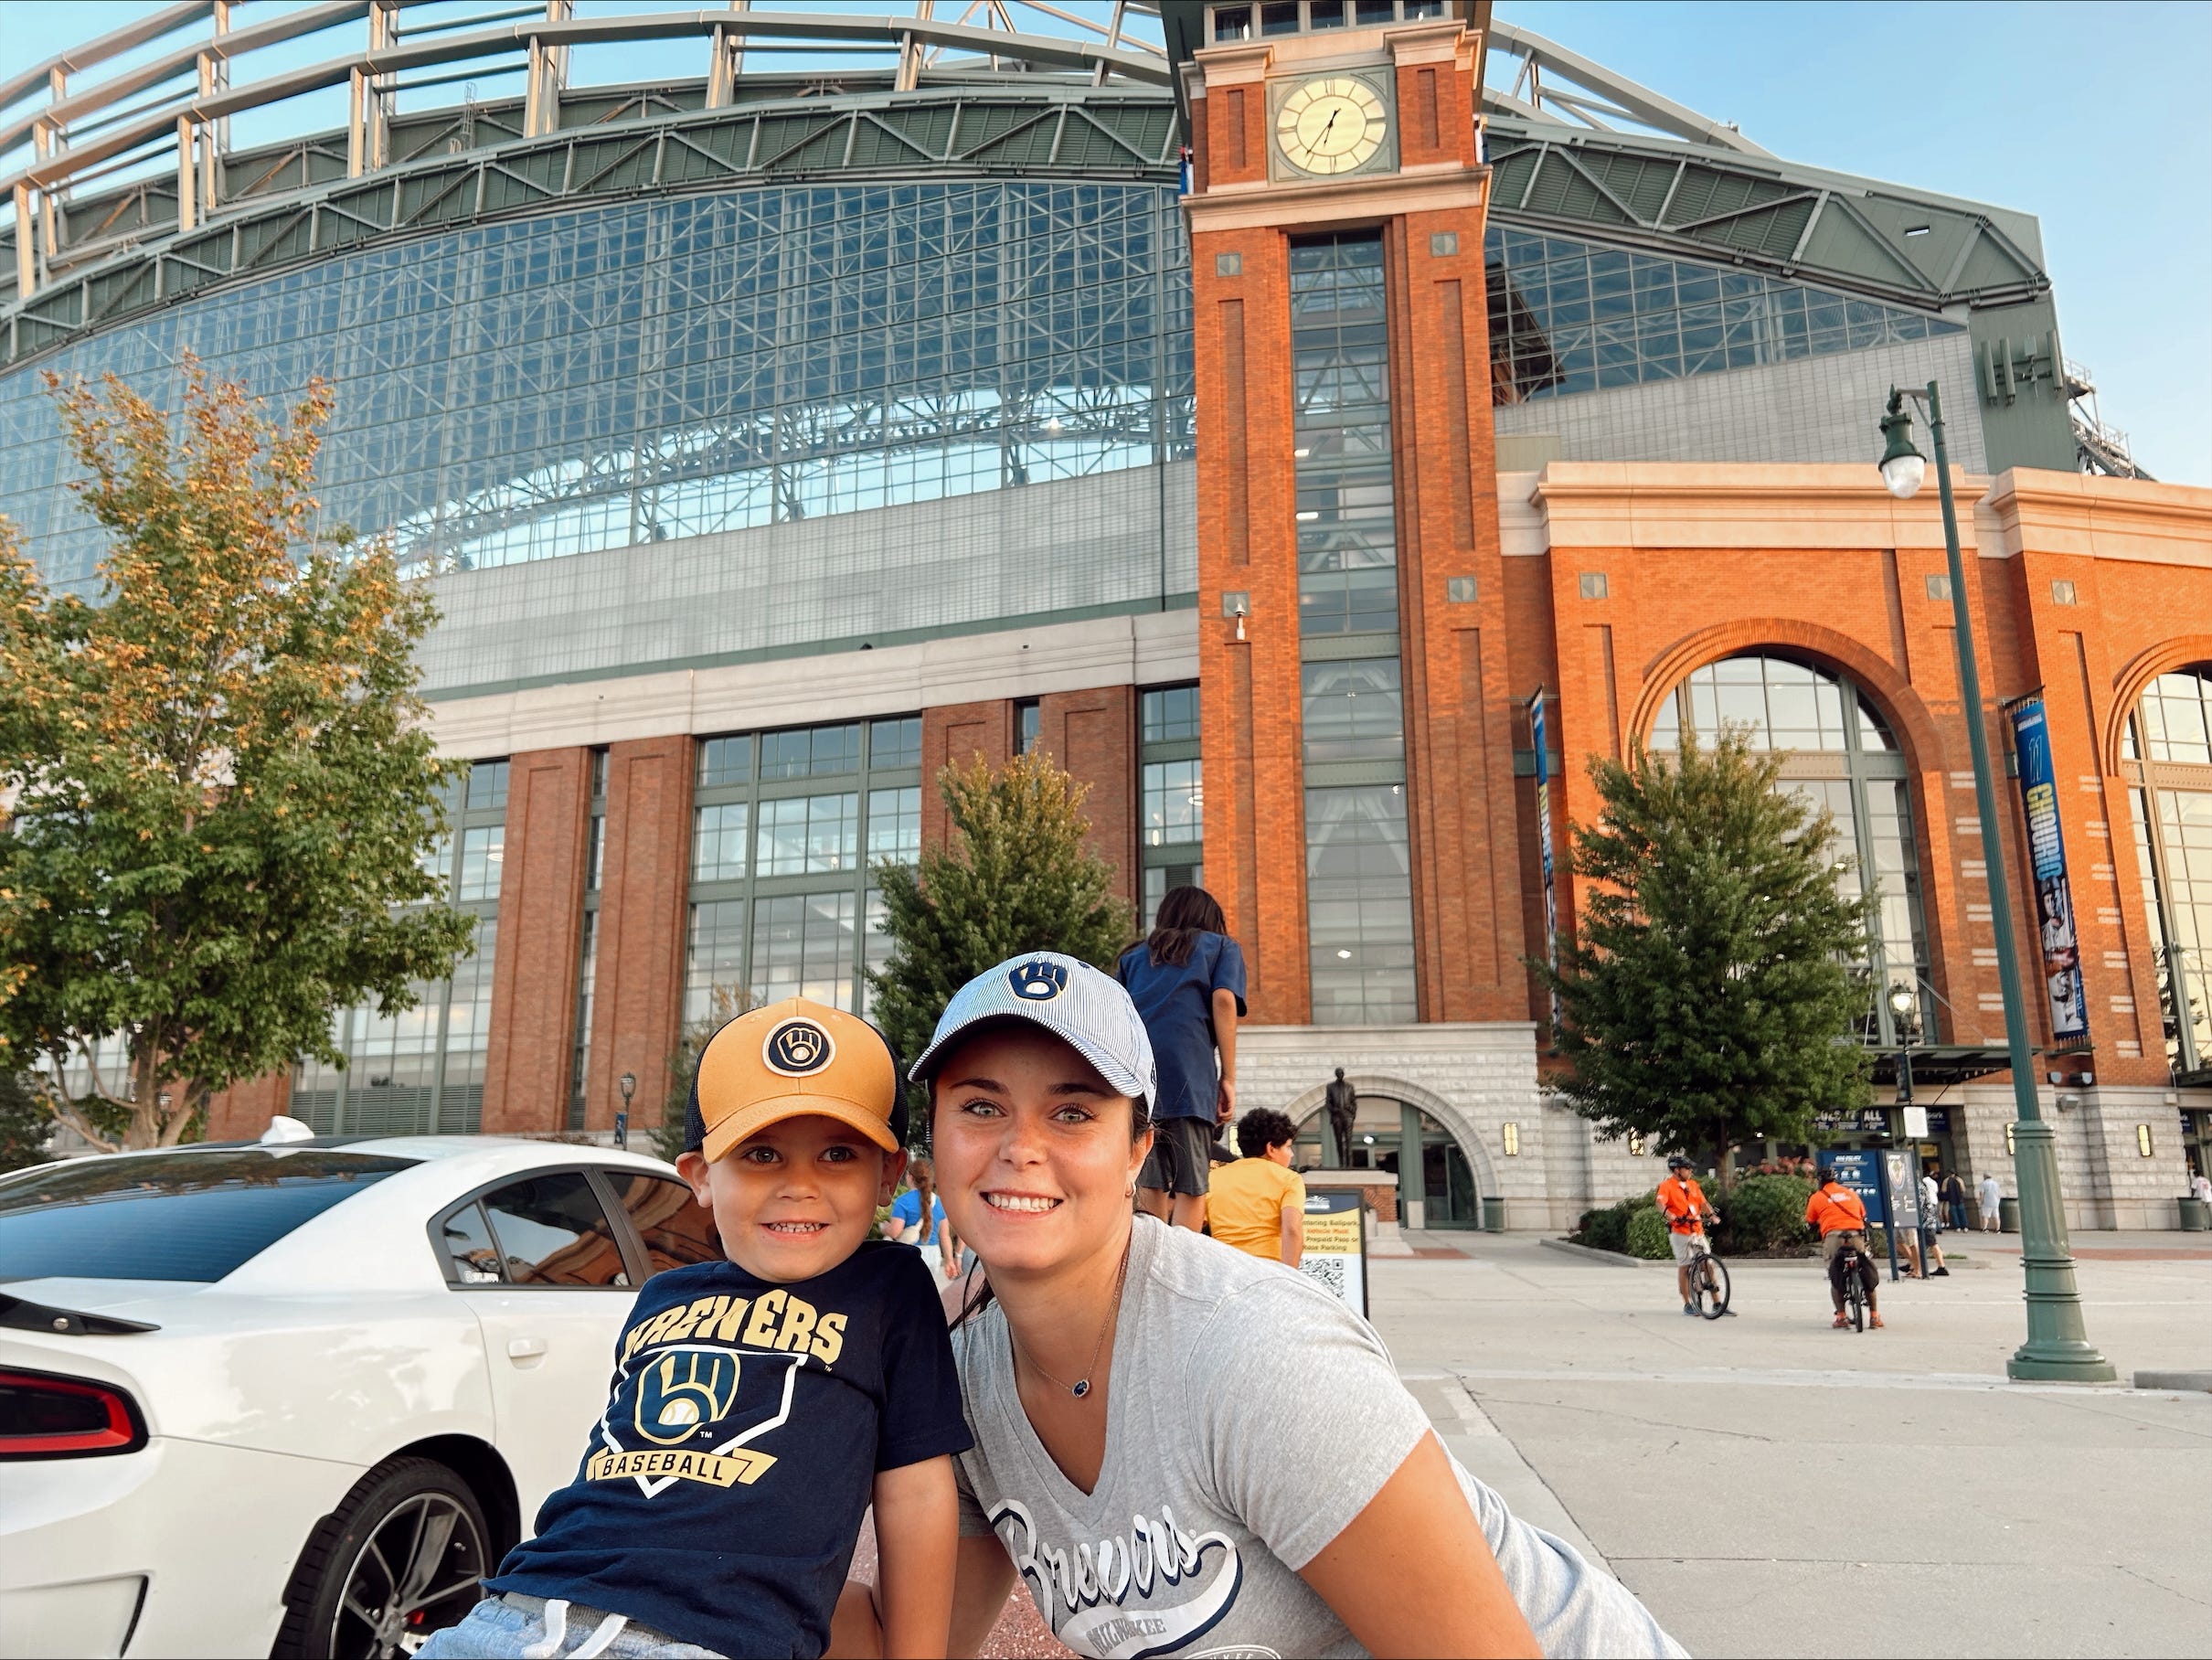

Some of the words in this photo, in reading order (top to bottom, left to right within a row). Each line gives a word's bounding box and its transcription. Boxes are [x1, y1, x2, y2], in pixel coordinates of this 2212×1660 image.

[2026, 782, 2063, 881] CHOURIO
[1864, 1110, 1883, 1122] ALL
[1321, 1243, 1347, 1251] Parking
[602, 1453, 724, 1482] BASEBALL
[1086, 1617, 1166, 1657] MILWKEE
